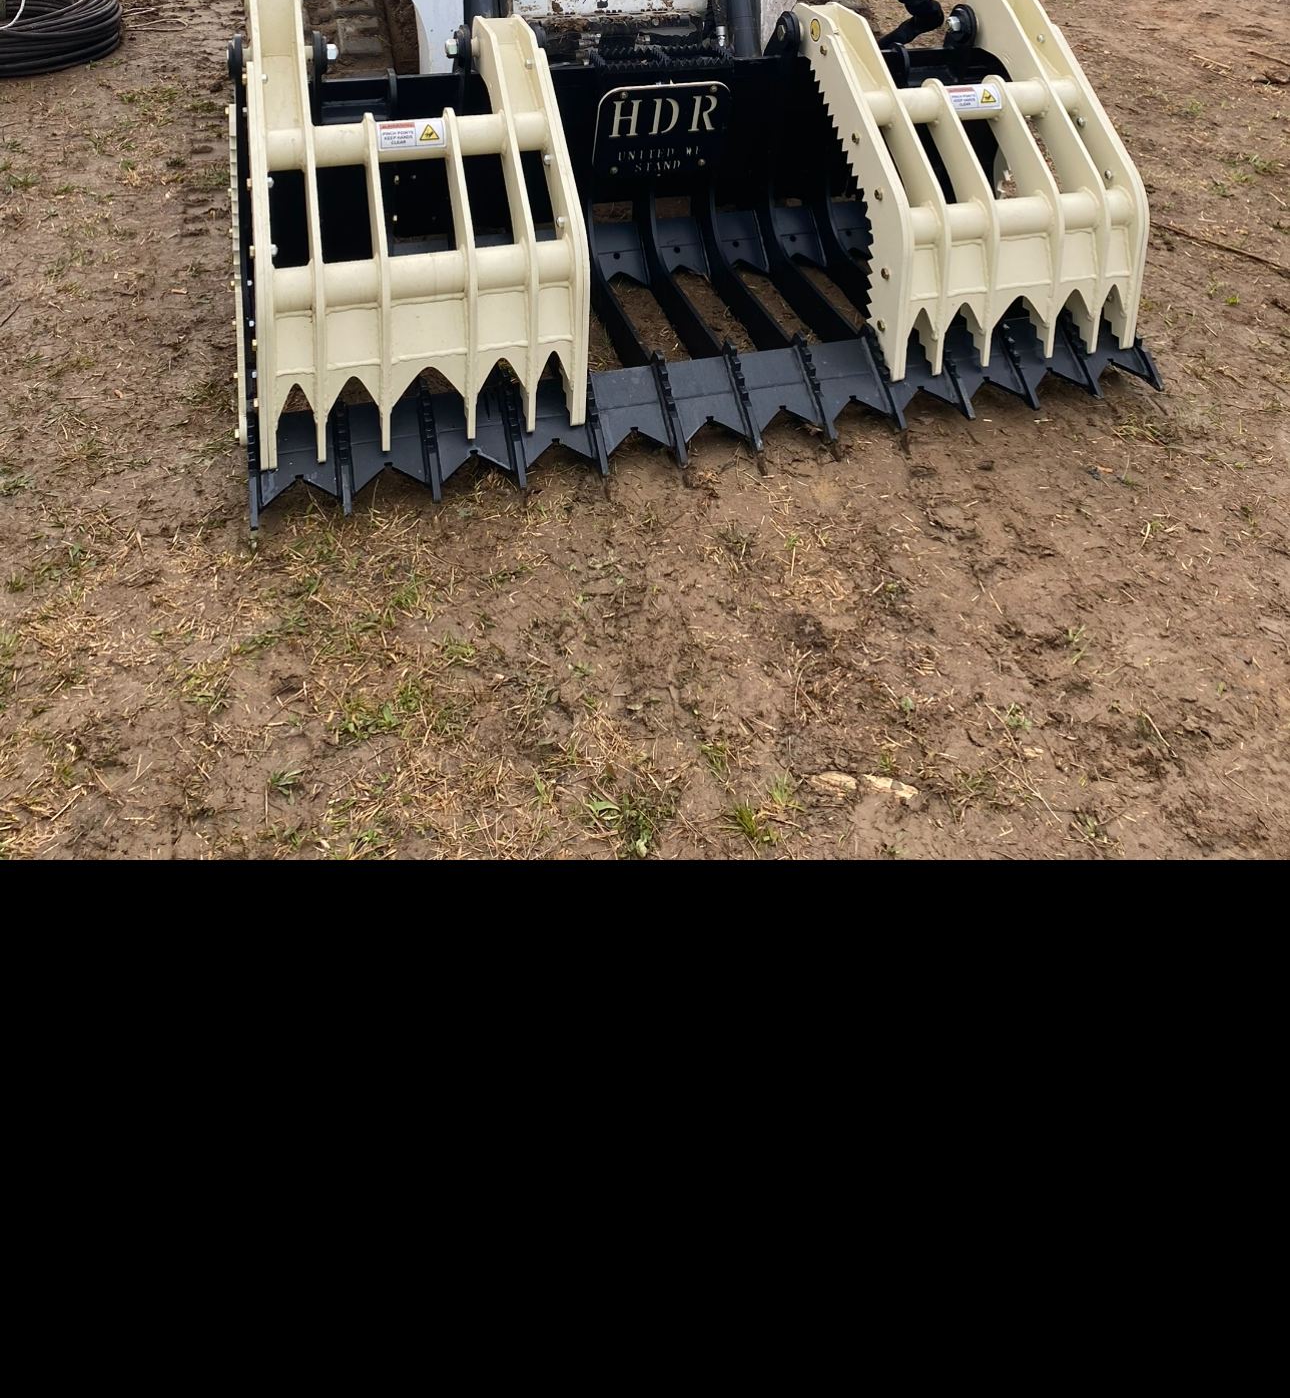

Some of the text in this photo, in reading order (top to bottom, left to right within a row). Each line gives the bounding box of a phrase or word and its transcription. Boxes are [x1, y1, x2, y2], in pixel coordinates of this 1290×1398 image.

[608, 95, 718, 138] HDR
[618, 144, 703, 162] UNITED WE
[634, 159, 681, 172] STAND
